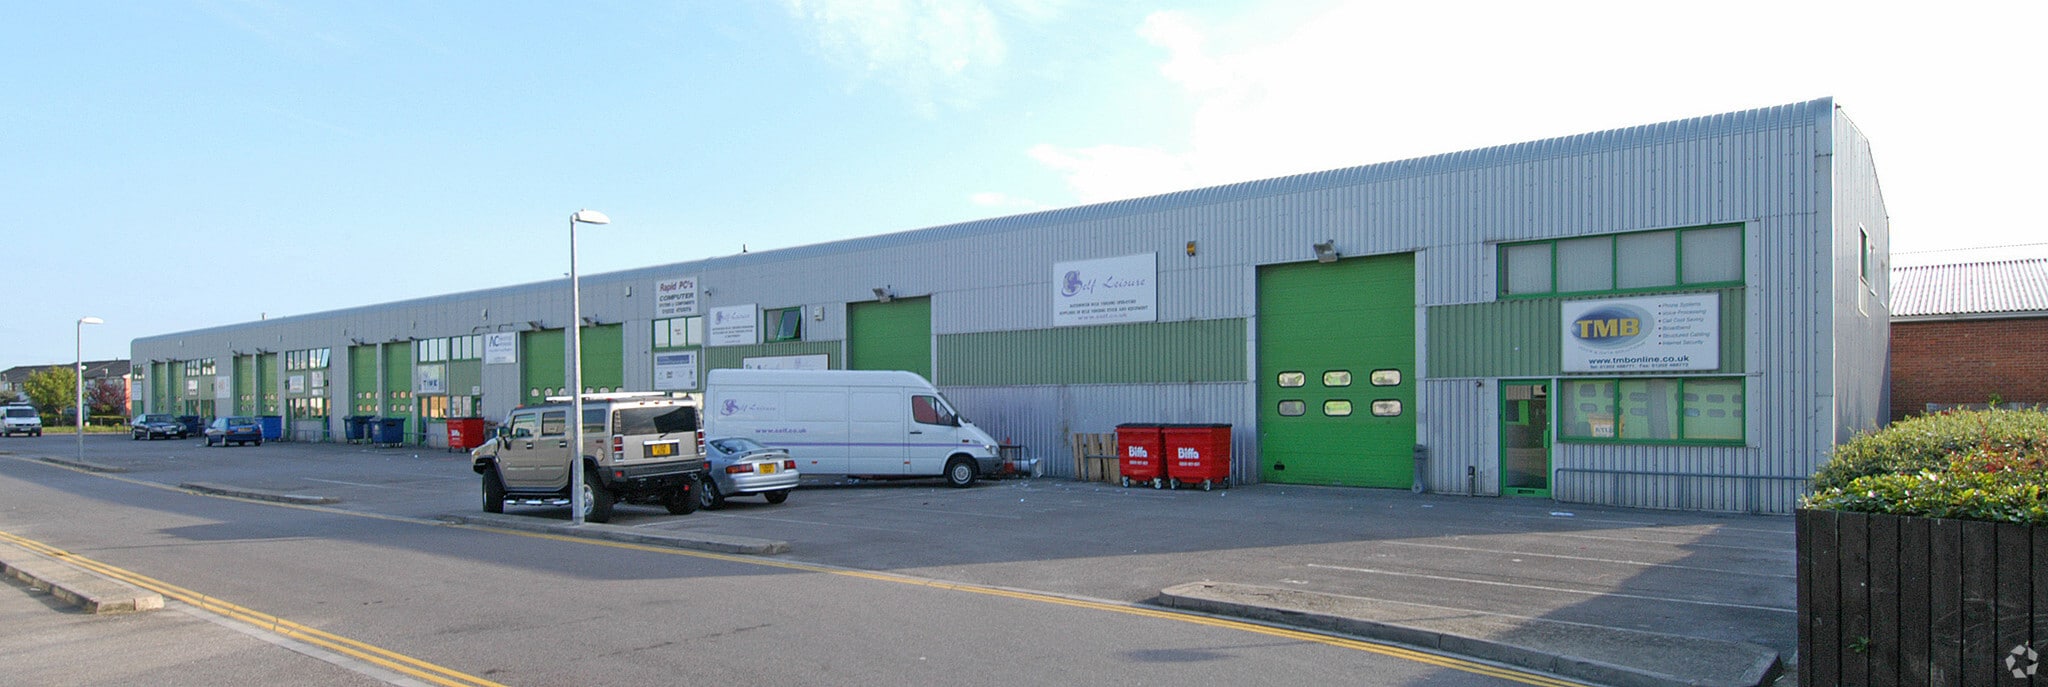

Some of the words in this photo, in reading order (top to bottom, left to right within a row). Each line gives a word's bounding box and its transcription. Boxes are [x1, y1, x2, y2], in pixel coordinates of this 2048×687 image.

[660, 281, 677, 293] Rapid
[1103, 275, 1146, 289] Leisure
[659, 292, 694, 302] COMPUTER
[1576, 318, 1640, 338] TMB
[1588, 354, 1690, 365] www.tmbonline.co.uk
[1128, 445, 1148, 458] Biffa
[1178, 447, 1200, 459] Biffa
